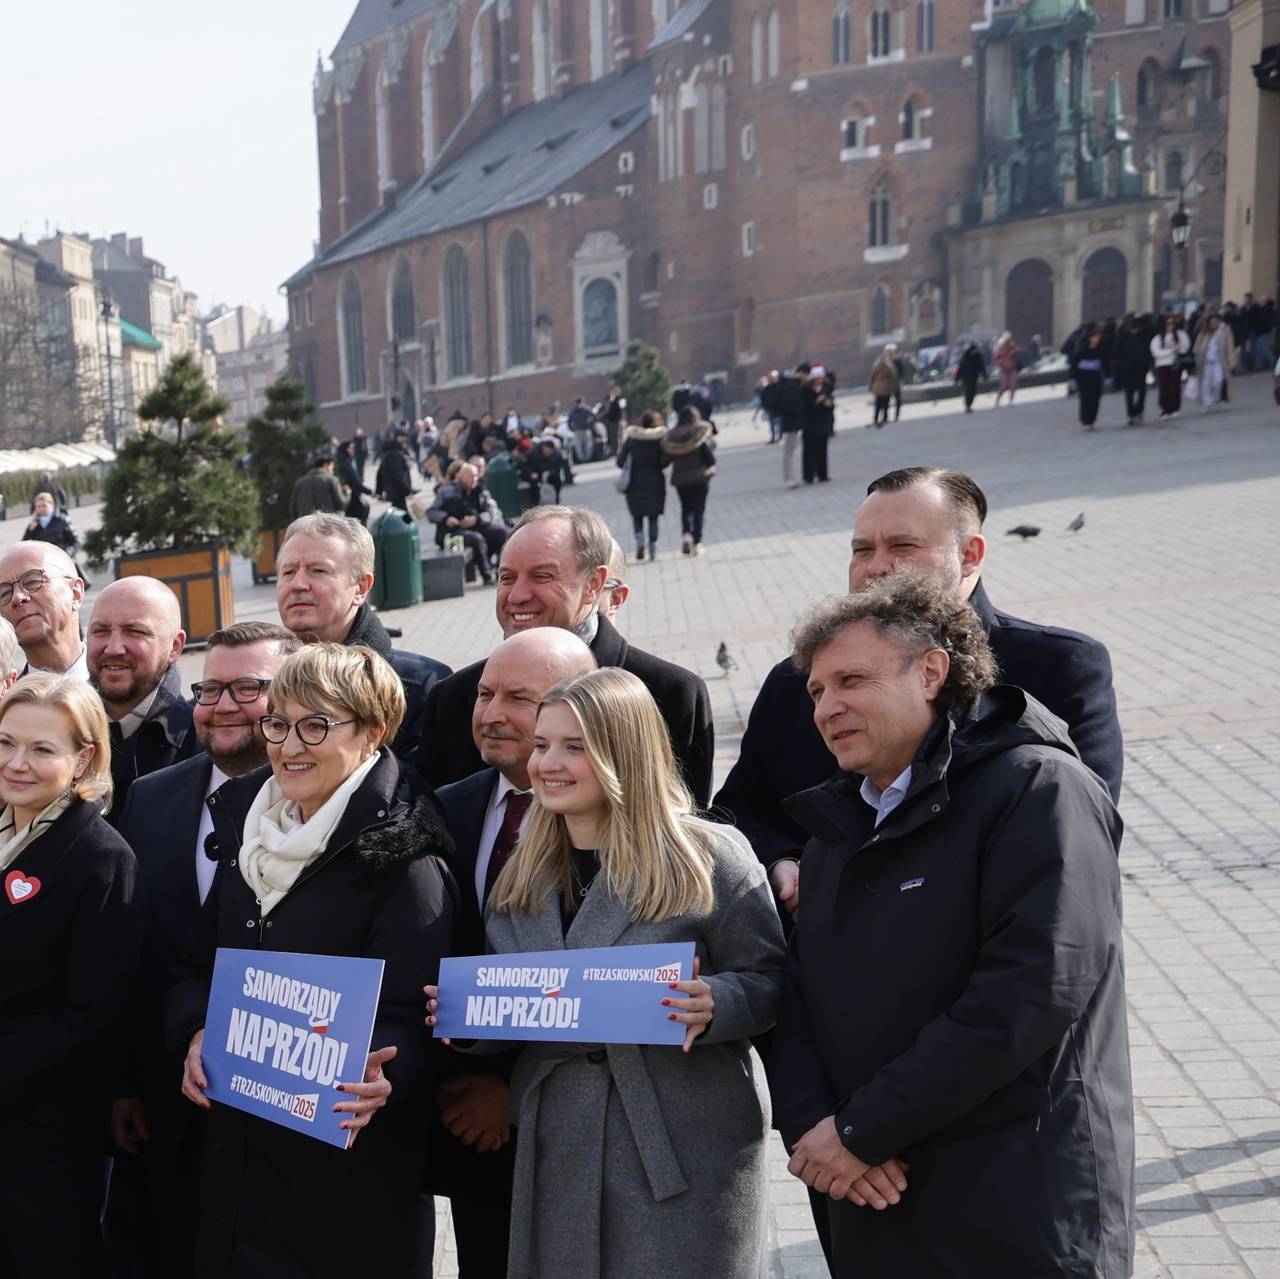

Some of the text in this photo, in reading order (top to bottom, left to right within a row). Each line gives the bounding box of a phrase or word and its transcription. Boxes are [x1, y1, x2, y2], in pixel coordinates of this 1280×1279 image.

[243, 966, 342, 1026] SAMORZĄDY
[476, 967, 569, 992] SAMORZĄDY
[465, 994, 581, 1029] NAPRZÓD!
[226, 1007, 349, 1089] NAPRZÓD!
